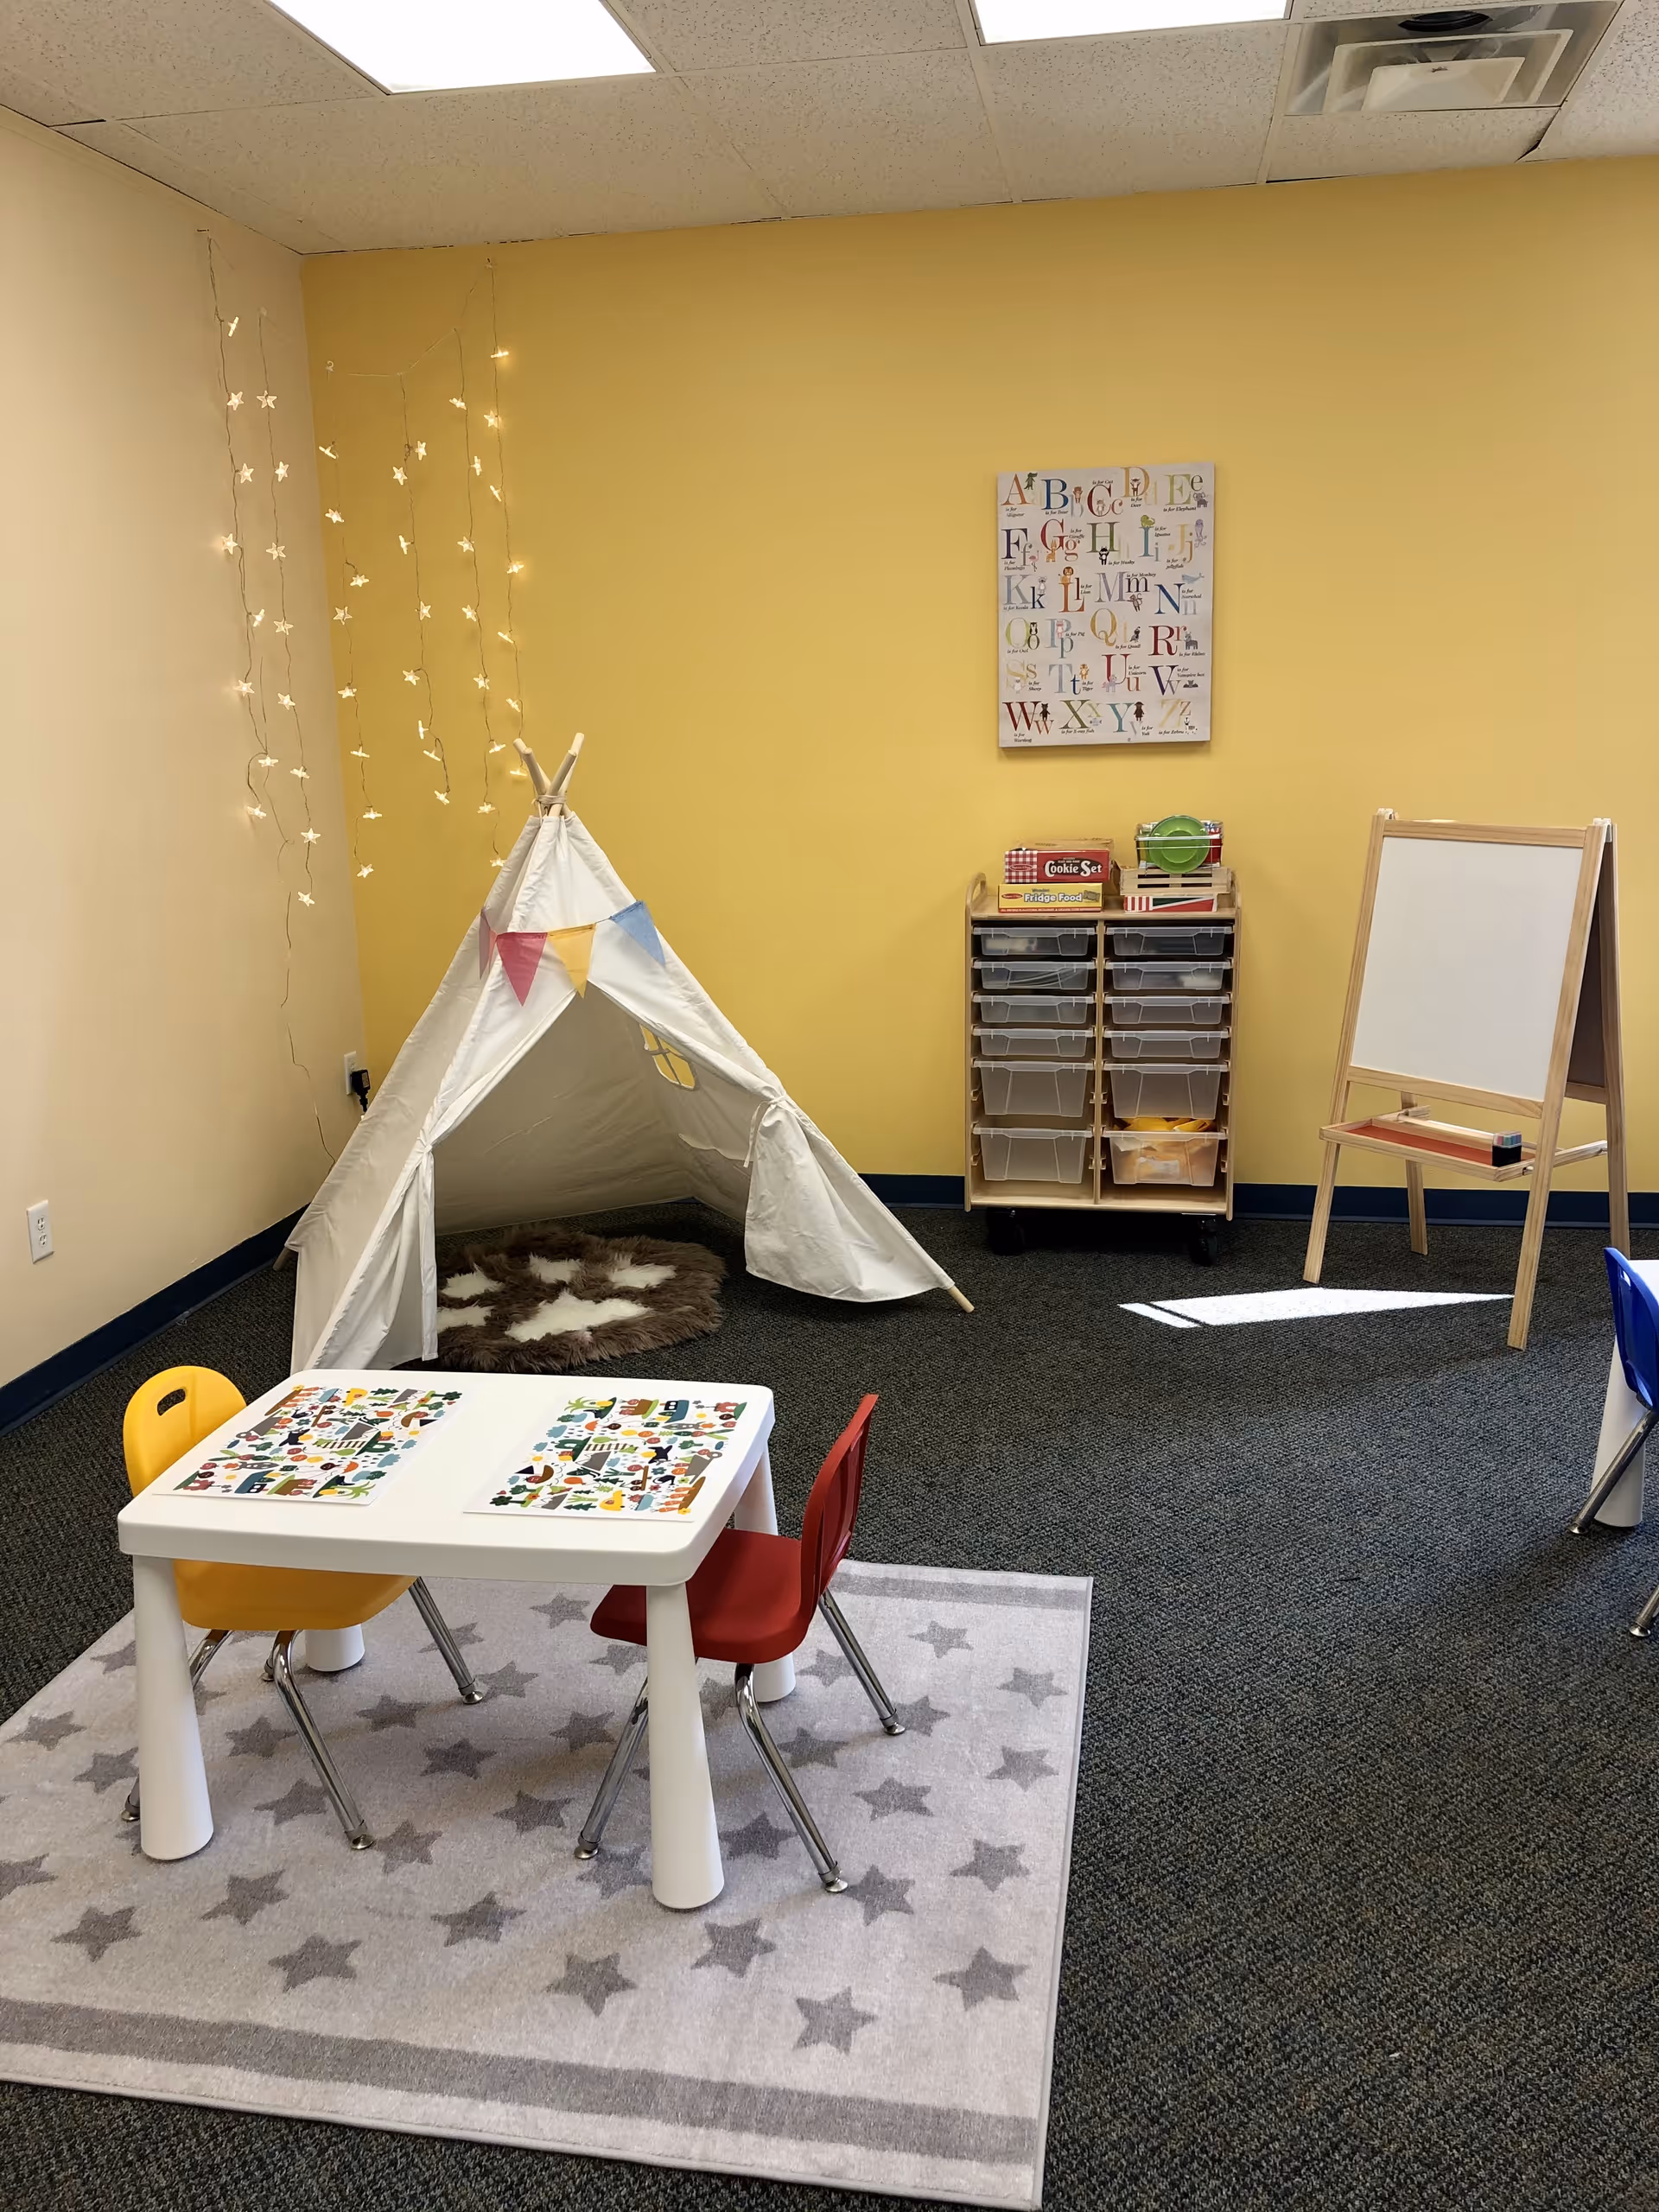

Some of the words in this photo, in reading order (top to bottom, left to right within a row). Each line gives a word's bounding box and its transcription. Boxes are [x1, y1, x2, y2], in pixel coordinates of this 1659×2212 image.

[1045, 861, 1079, 877] Cookie
[1080, 861, 1102, 877] Set
[1024, 893, 1057, 903] Fridge
[1058, 893, 1083, 902] Food
